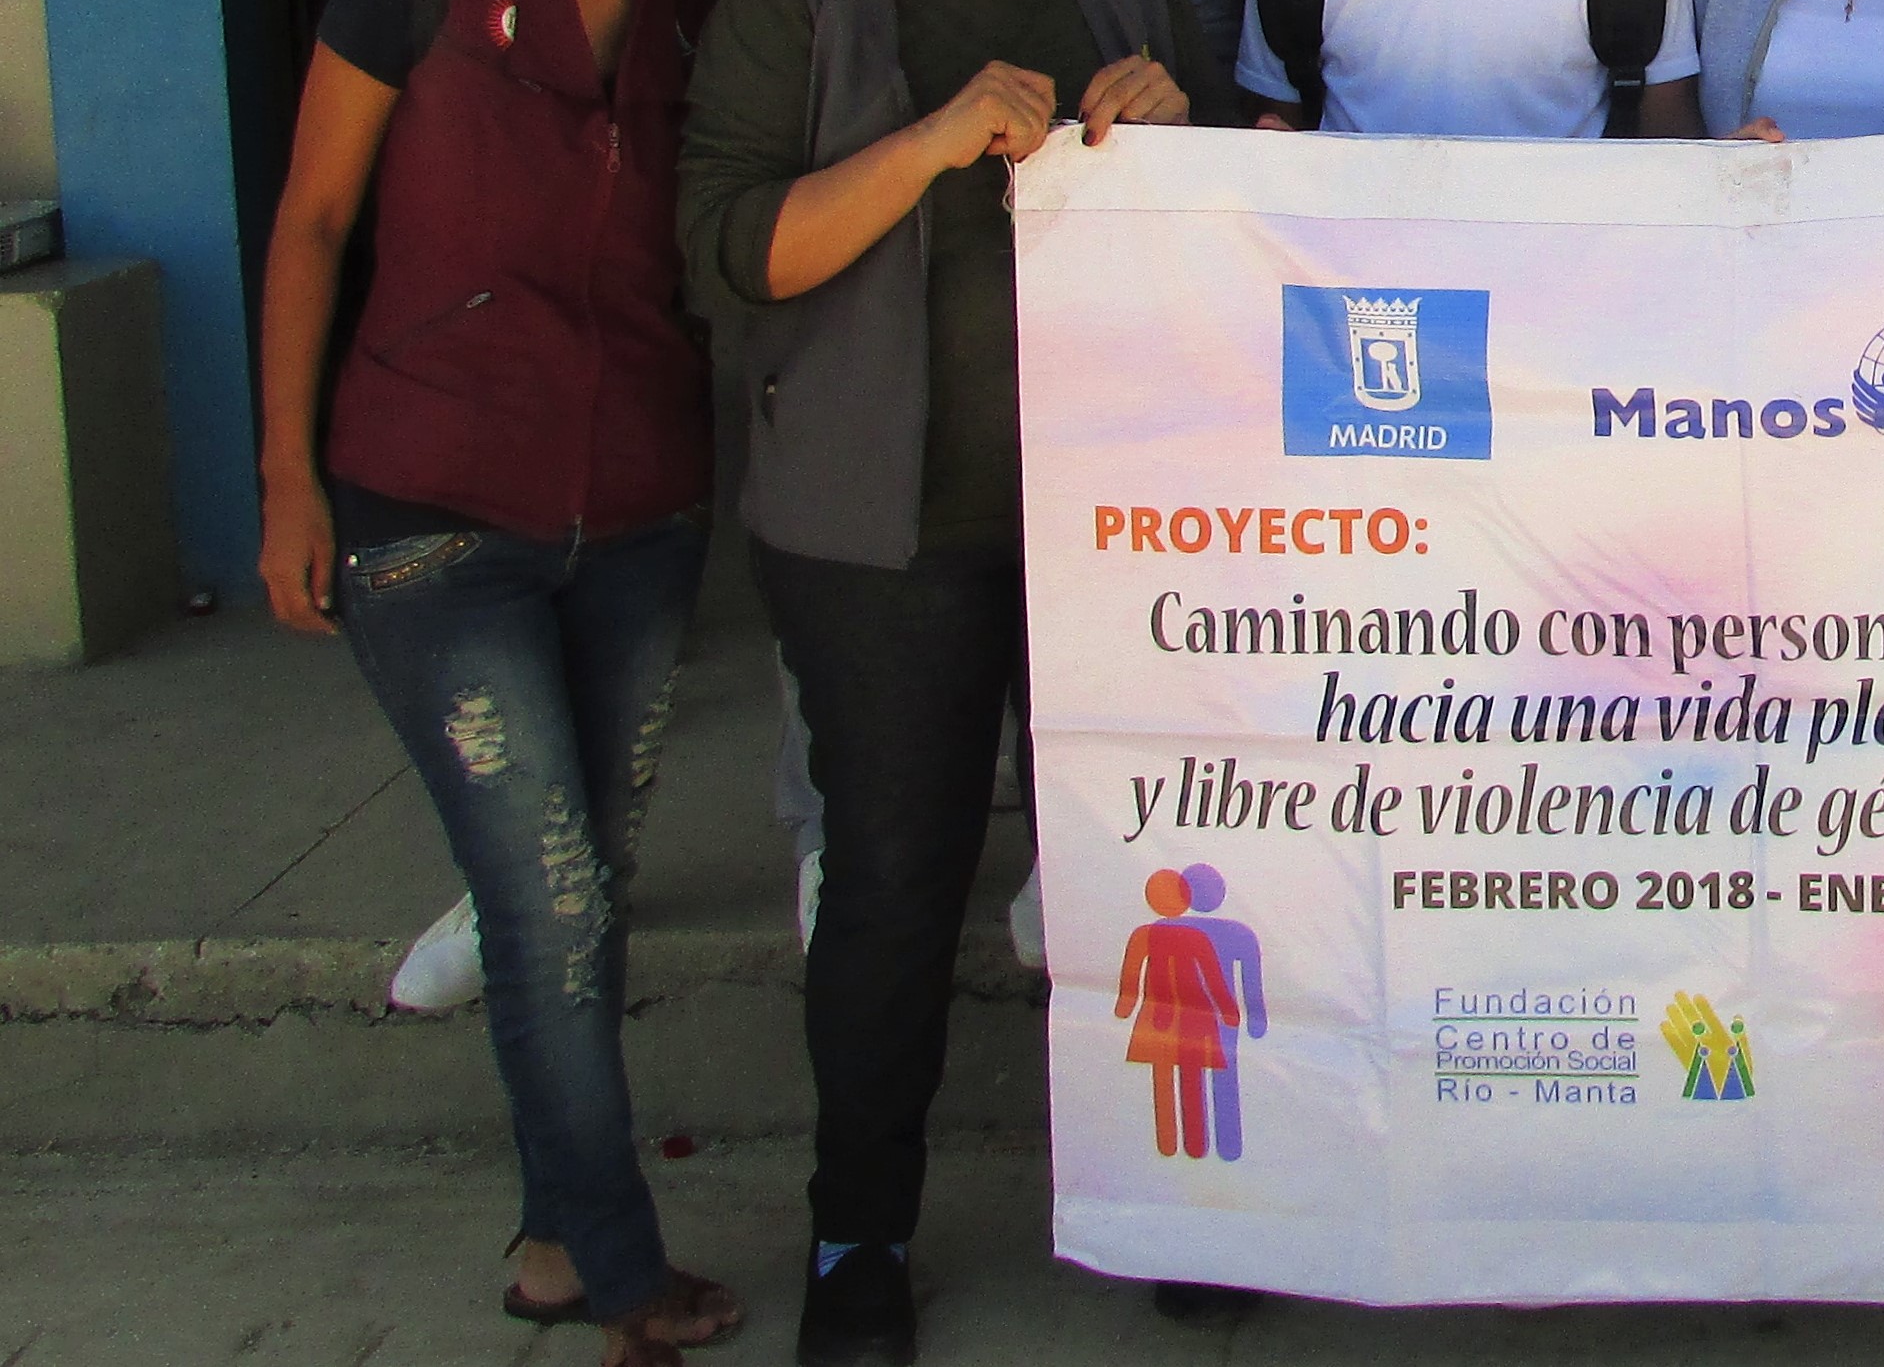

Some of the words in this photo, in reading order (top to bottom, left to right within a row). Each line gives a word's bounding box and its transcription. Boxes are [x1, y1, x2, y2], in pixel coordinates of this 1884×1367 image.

[1591, 387, 1847, 440] Manos
[1329, 424, 1447, 451] MADRID
[1094, 505, 1429, 556] PROYECTO:
[1150, 588, 1521, 656] Caminando
[1538, 609, 1652, 658] con
[1316, 672, 1493, 745] hacia
[1510, 694, 1641, 744] una
[1655, 674, 1792, 745] vida
[1123, 776, 1166, 844] y
[1175, 756, 1317, 832] libre
[1330, 763, 1403, 837] de
[1418, 762, 1714, 837] violencia
[1729, 763, 1803, 838] de
[1393, 870, 1619, 911] FEBRERO
[1635, 870, 1755, 911] 2018
[1434, 986, 1636, 1016] Fundación
[1434, 1023, 1570, 1052] Centro
[1591, 1025, 1636, 1052] de
[1435, 1049, 1561, 1071] Promoción
[1567, 1048, 1637, 1072] Social
[1436, 1077, 1493, 1103] Río
[1535, 1076, 1640, 1105] Manta
